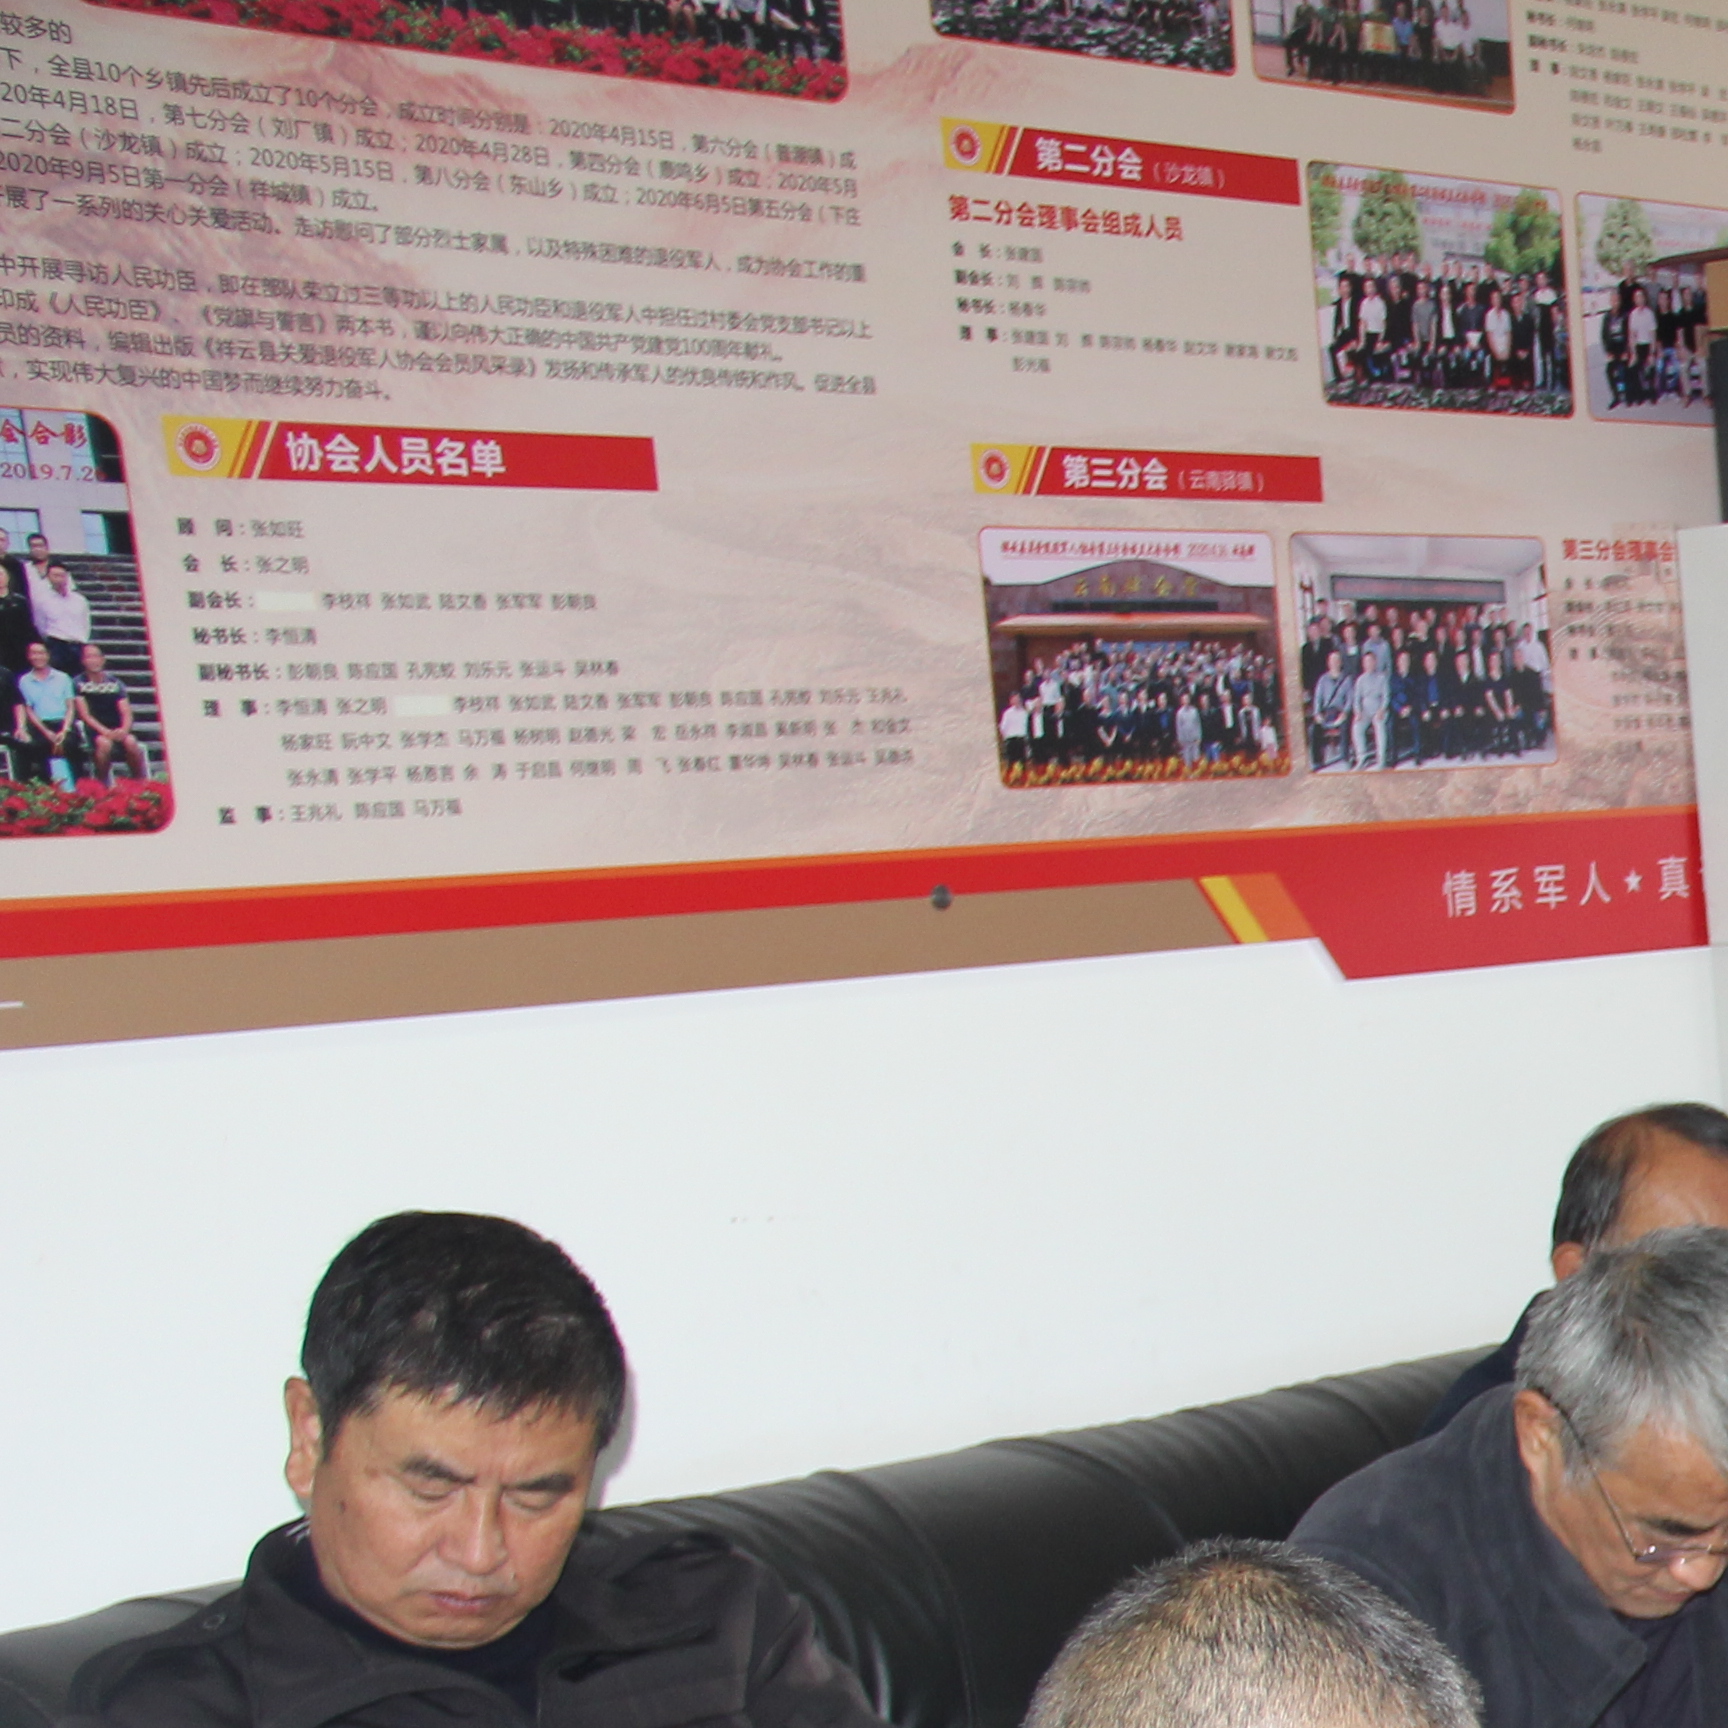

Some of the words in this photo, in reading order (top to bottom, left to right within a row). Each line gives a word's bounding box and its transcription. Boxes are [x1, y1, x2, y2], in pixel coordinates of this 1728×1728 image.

[1034, 136, 1143, 181] 第二分会
[950, 195, 1184, 241] 第二分会理事会组成人员
[287, 431, 506, 478] 协会人员名单
[1061, 453, 1169, 491] 第三分会
[183, 554, 200, 574] 会
[1443, 862, 1612, 919] 情系军人
[1657, 854, 1689, 903] 真
